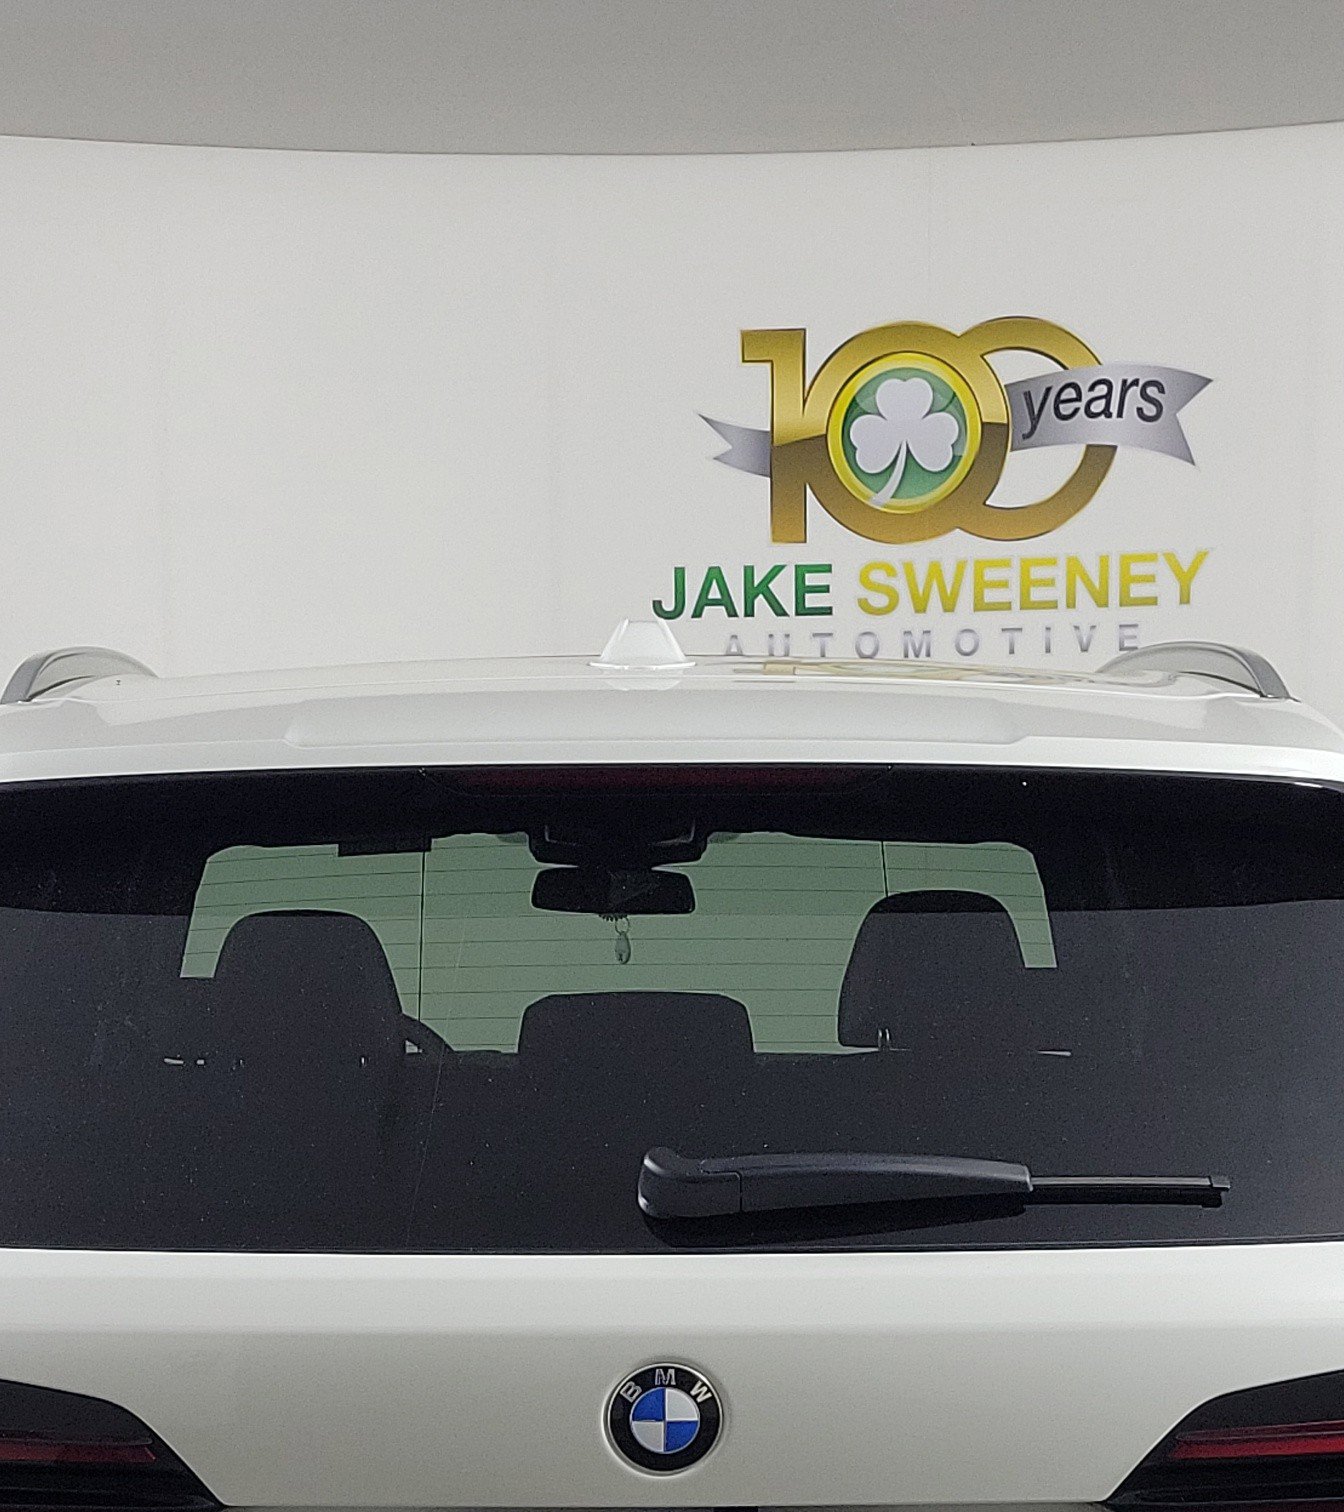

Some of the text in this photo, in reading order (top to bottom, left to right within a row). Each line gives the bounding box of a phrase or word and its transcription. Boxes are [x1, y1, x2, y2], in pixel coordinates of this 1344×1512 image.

[741, 317, 1166, 546] 100 years
[652, 550, 1210, 620] JAKE SWEENEY
[725, 624, 1141, 660] AUTOMOTIVE
[620, 1368, 712, 1403] BMW
